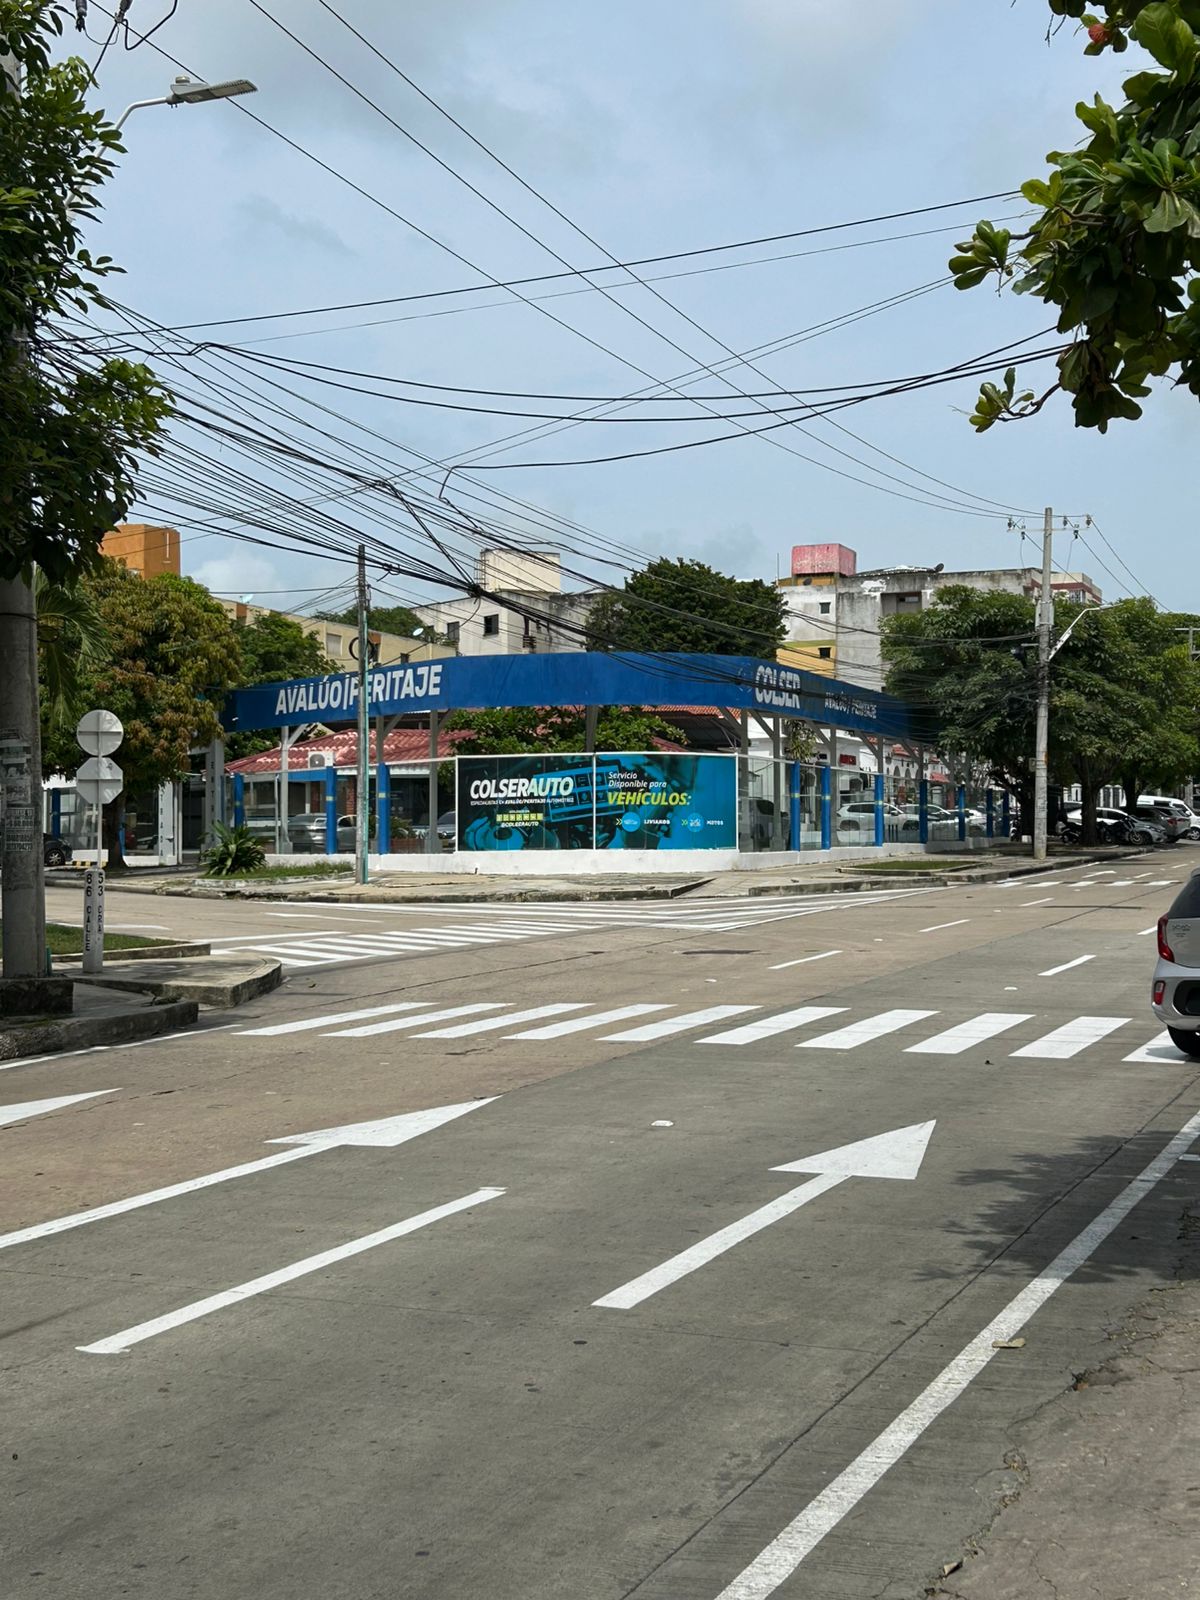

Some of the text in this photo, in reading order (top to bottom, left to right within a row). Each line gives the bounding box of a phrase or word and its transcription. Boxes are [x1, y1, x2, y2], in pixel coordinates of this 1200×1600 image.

[755, 665, 800, 709] COLSER
[608, 771, 638, 780] Servicio
[608, 780, 667, 789] Disponible para
[470, 777, 574, 799] COLSERAUTO
[607, 788, 692, 806] VEHÍCULOS:
